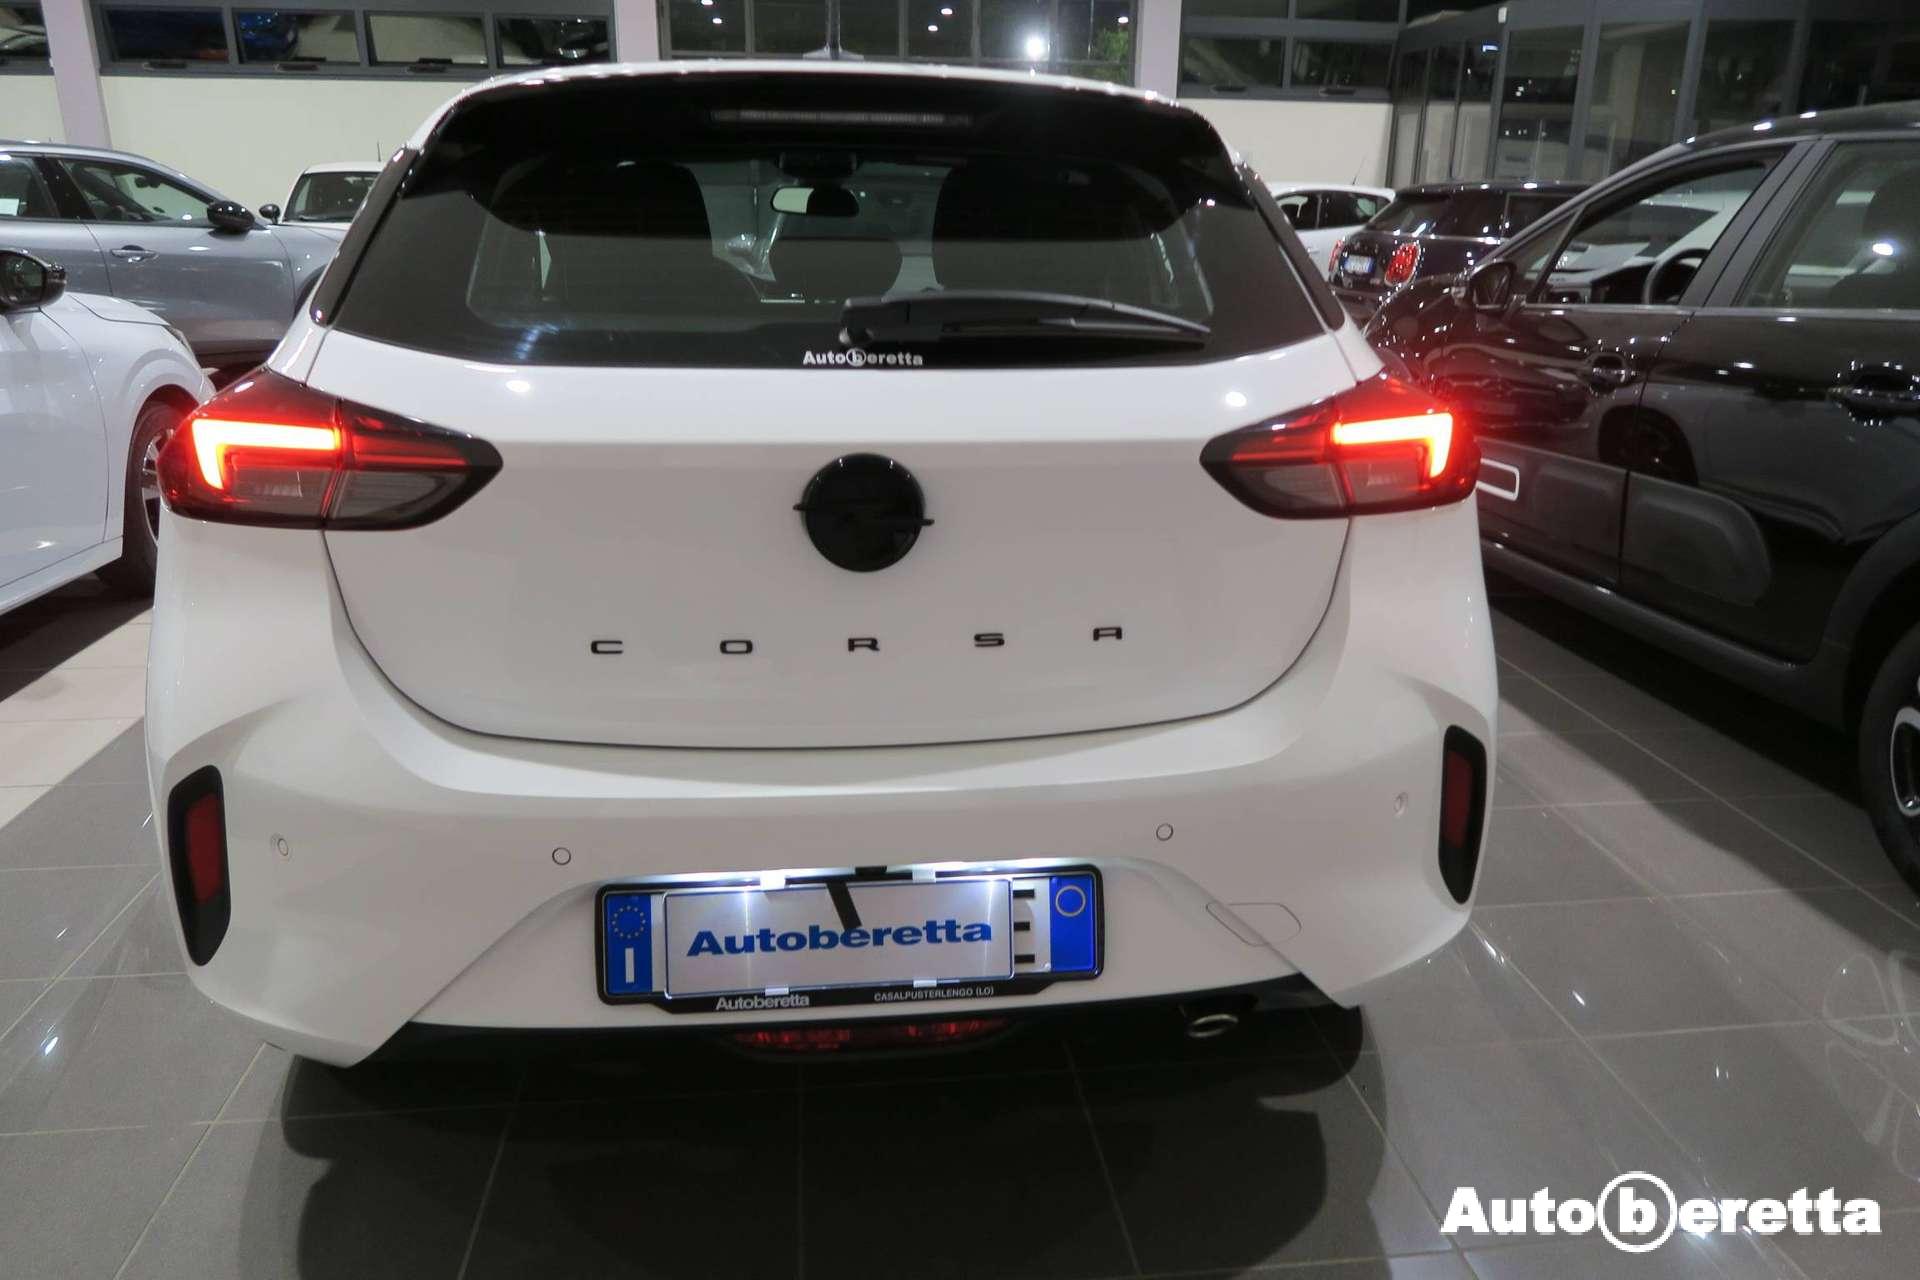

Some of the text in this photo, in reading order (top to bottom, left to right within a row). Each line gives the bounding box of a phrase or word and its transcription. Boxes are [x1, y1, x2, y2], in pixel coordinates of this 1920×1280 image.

[802, 348, 924, 367] Autoberetta
[590, 626, 1123, 655] CORSA
[686, 918, 992, 957] Autoberetta
[715, 994, 810, 1012] Autoberetta
[873, 985, 994, 1002] CASALPUSTERLENGO (LO)
